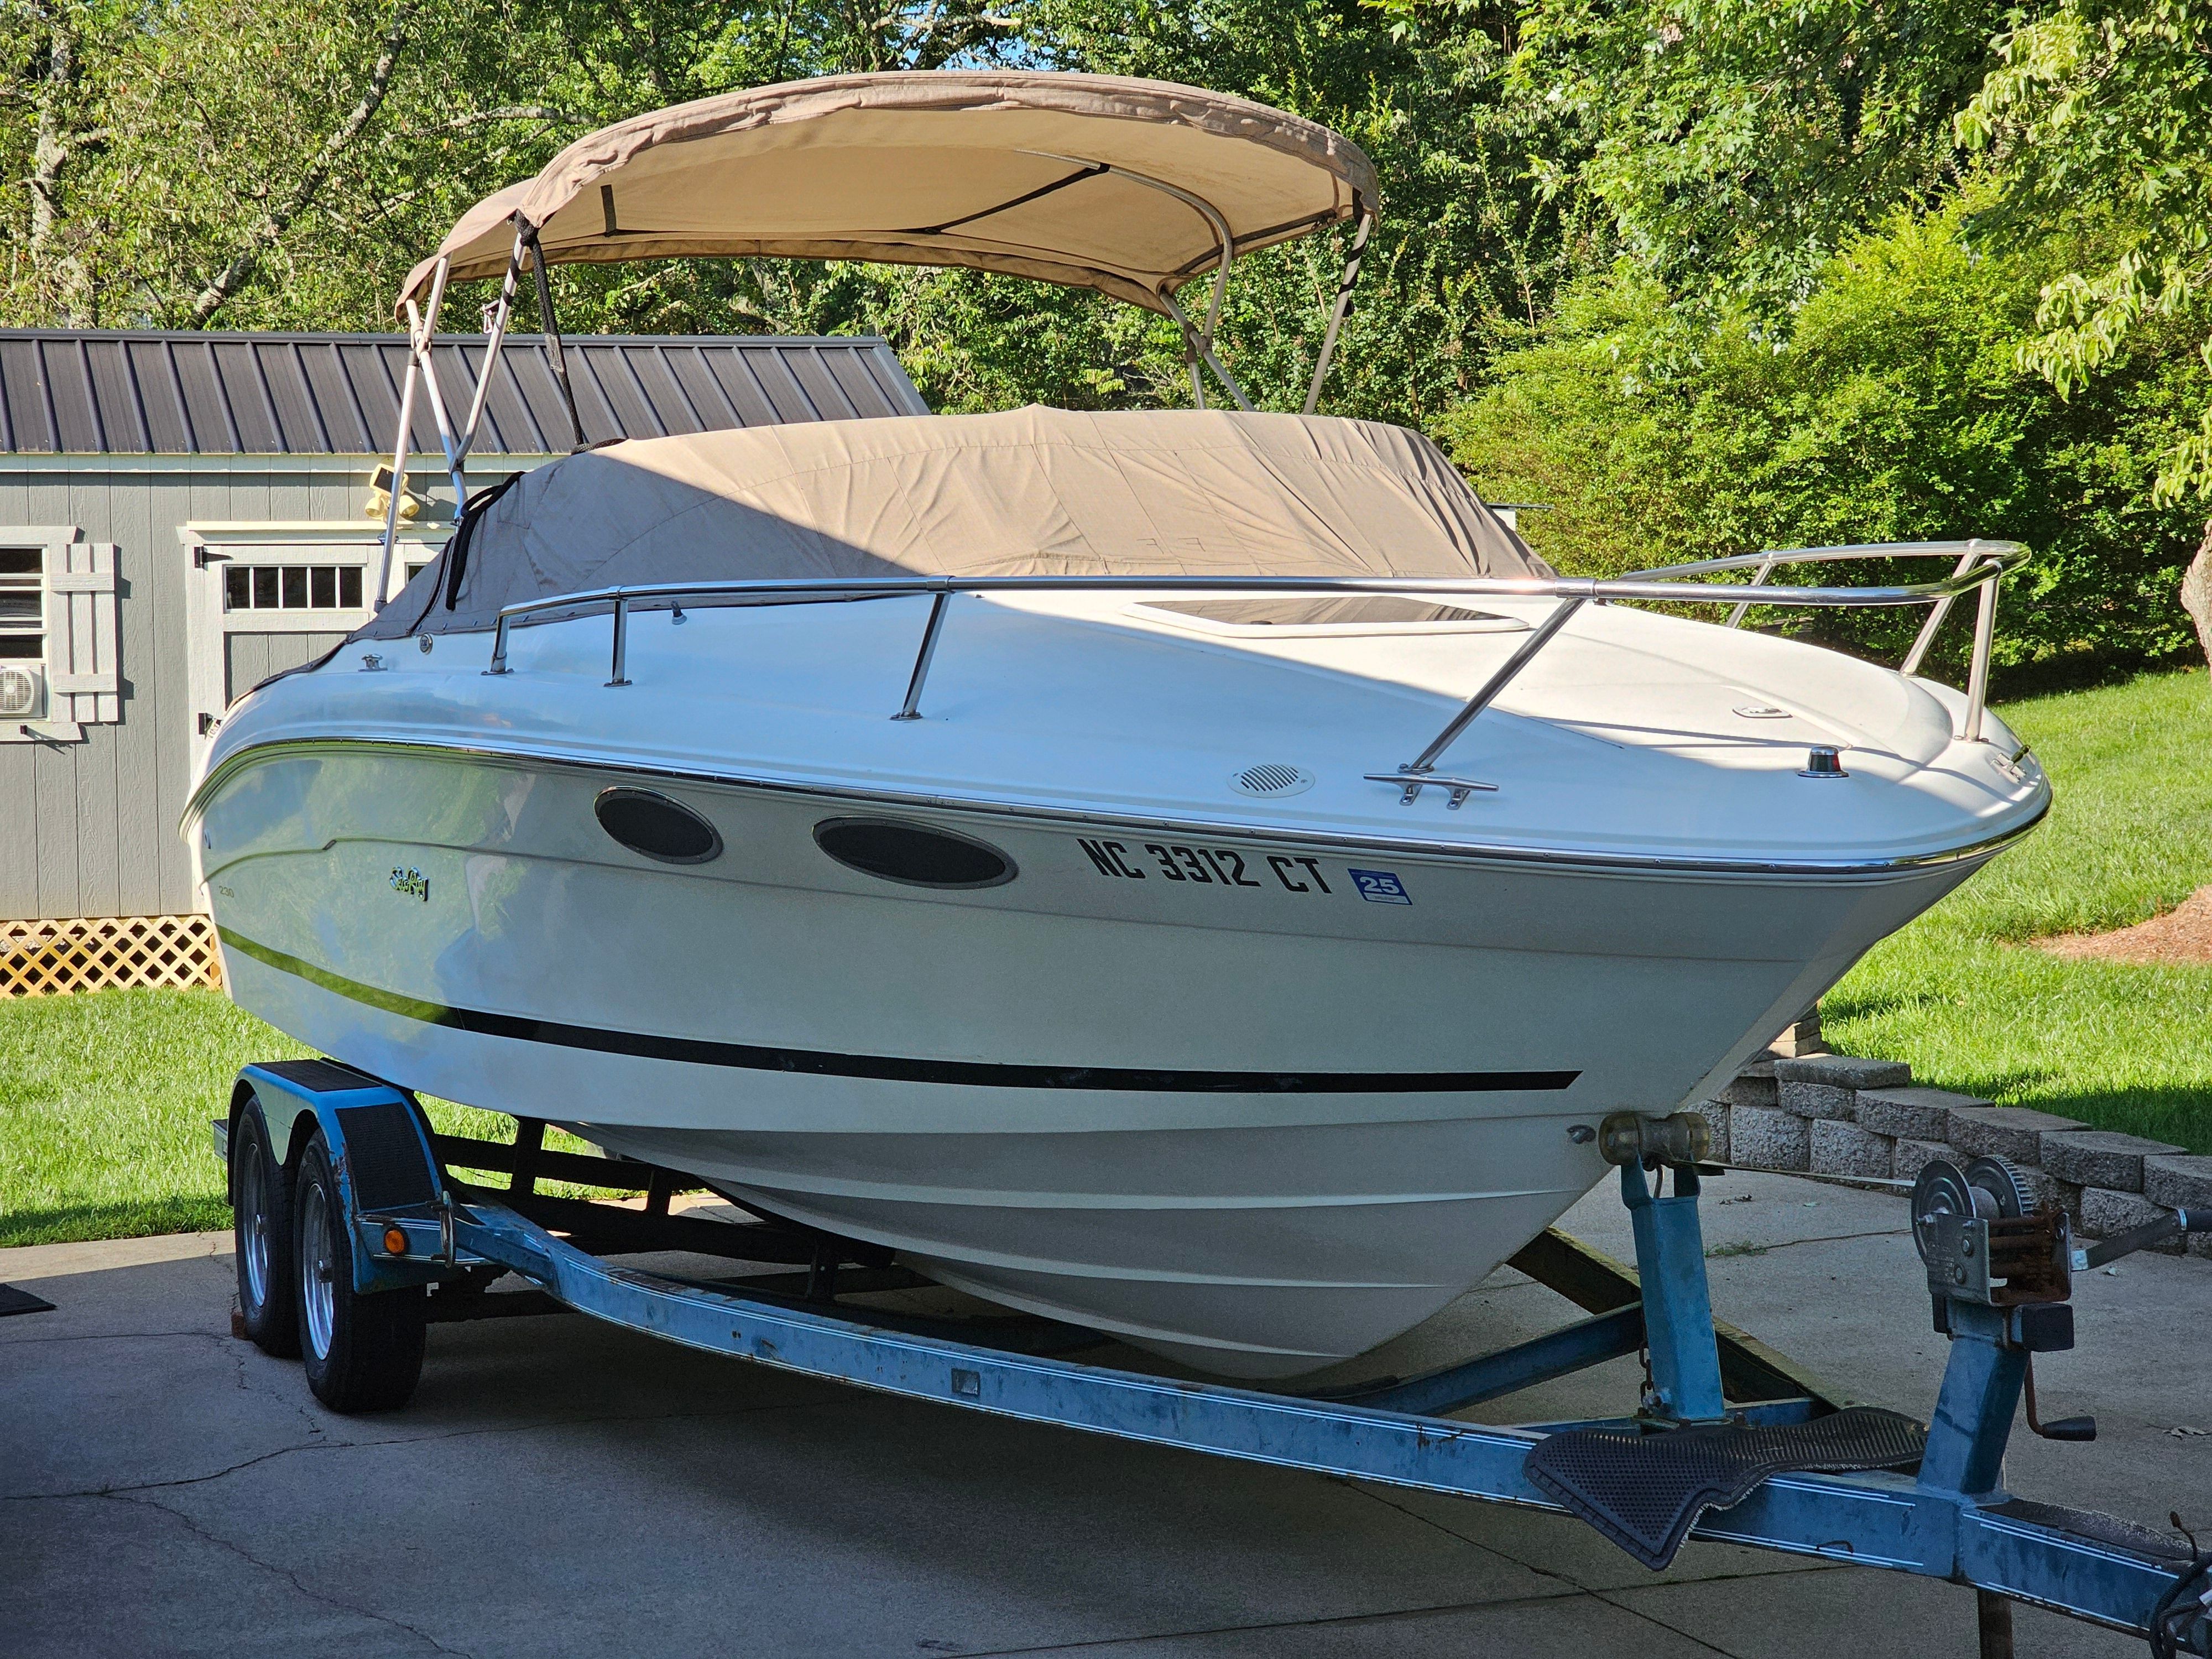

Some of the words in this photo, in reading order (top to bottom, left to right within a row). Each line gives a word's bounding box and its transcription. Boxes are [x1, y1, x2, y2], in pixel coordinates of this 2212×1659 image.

[1076, 838, 1145, 878] NC
[1144, 844, 1261, 887] 3312
[1266, 855, 1332, 894] CT
[218, 885, 234, 898] 230
[1359, 876, 1400, 894] 25
